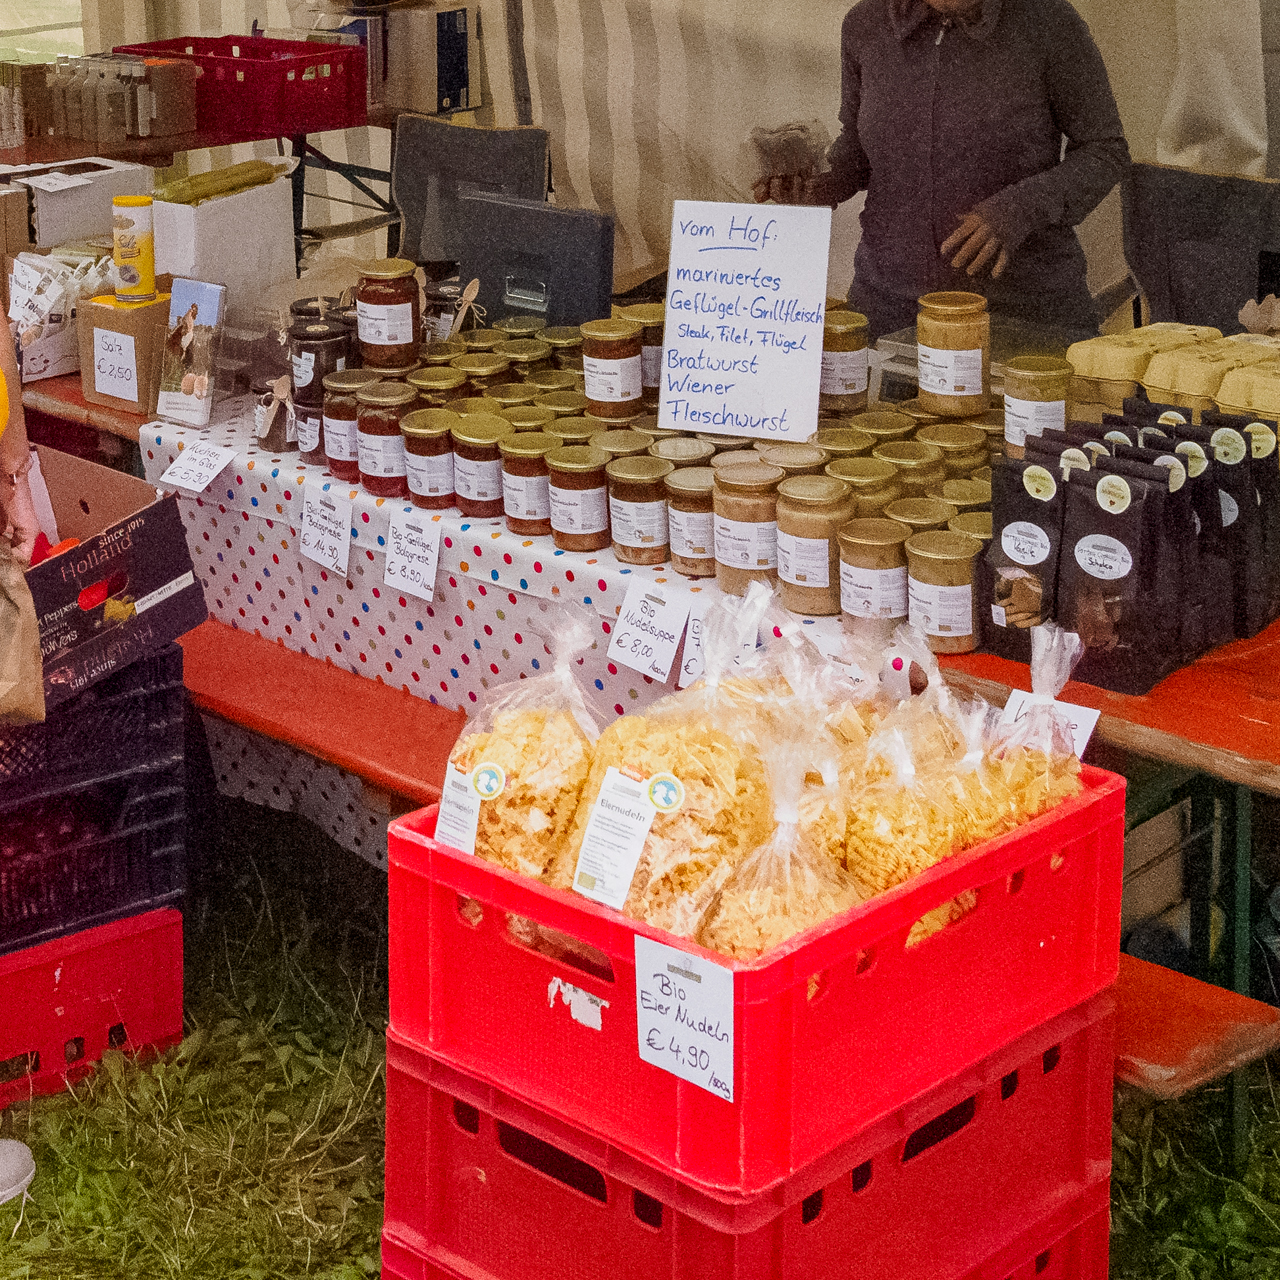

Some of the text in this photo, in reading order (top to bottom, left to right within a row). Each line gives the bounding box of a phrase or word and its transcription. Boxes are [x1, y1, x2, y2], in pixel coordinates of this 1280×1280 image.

[728, 215, 779, 249] Hof:
[676, 267, 782, 292] mariniertes
[669, 289, 824, 326] Geflügel-Grillfleisch
[100, 334, 124, 357] Salz
[757, 330, 807, 355] Flügel
[96, 358, 133, 382] € 2,50
[666, 348, 760, 375] Bratwurst
[666, 372, 737, 396] Wiener
[665, 399, 791, 433] Fleischwurst
[186, 454, 217, 471] im Glas
[188, 442, 221, 461] Kuchen
[167, 466, 210, 485] € 5,90
[98, 526, 125, 549] since
[301, 532, 311, 547] €
[305, 514, 343, 541] Bolognese
[60, 534, 134, 582] Holland
[393, 540, 431, 566] Bolognese
[386, 561, 397, 576] €
[399, 565, 421, 584] 8,90
[639, 599, 656, 618] Bio
[623, 609, 676, 644] Nudelsuppe
[615, 632, 654, 658] € 8,00
[599, 797, 646, 823] Eiernudeln
[652, 972, 687, 1001] Bio
[640, 989, 730, 1044] Eier Nudeln
[645, 1027, 710, 1071] € 4,90
